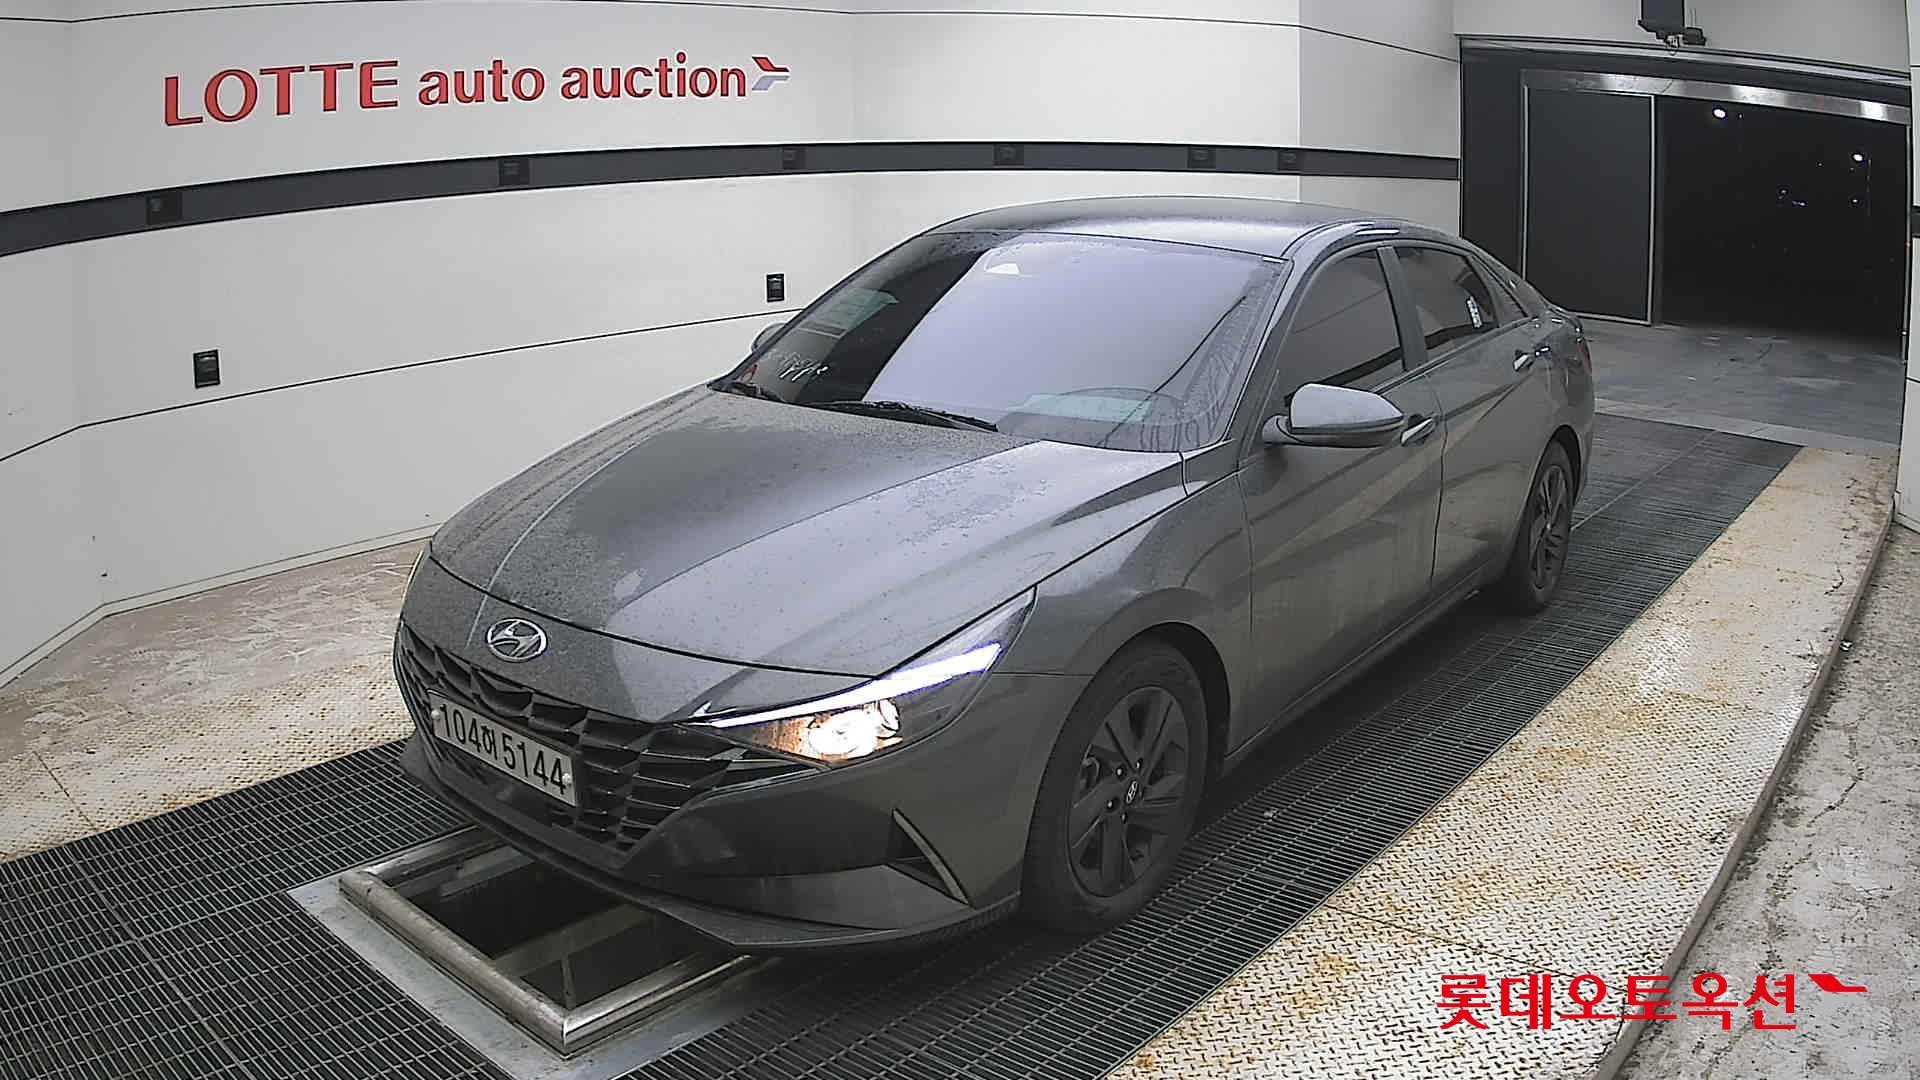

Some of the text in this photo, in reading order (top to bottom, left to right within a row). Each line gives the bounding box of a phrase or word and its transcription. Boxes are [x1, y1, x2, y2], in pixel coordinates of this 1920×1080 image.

[164, 51, 746, 126] LOTTE auto auction
